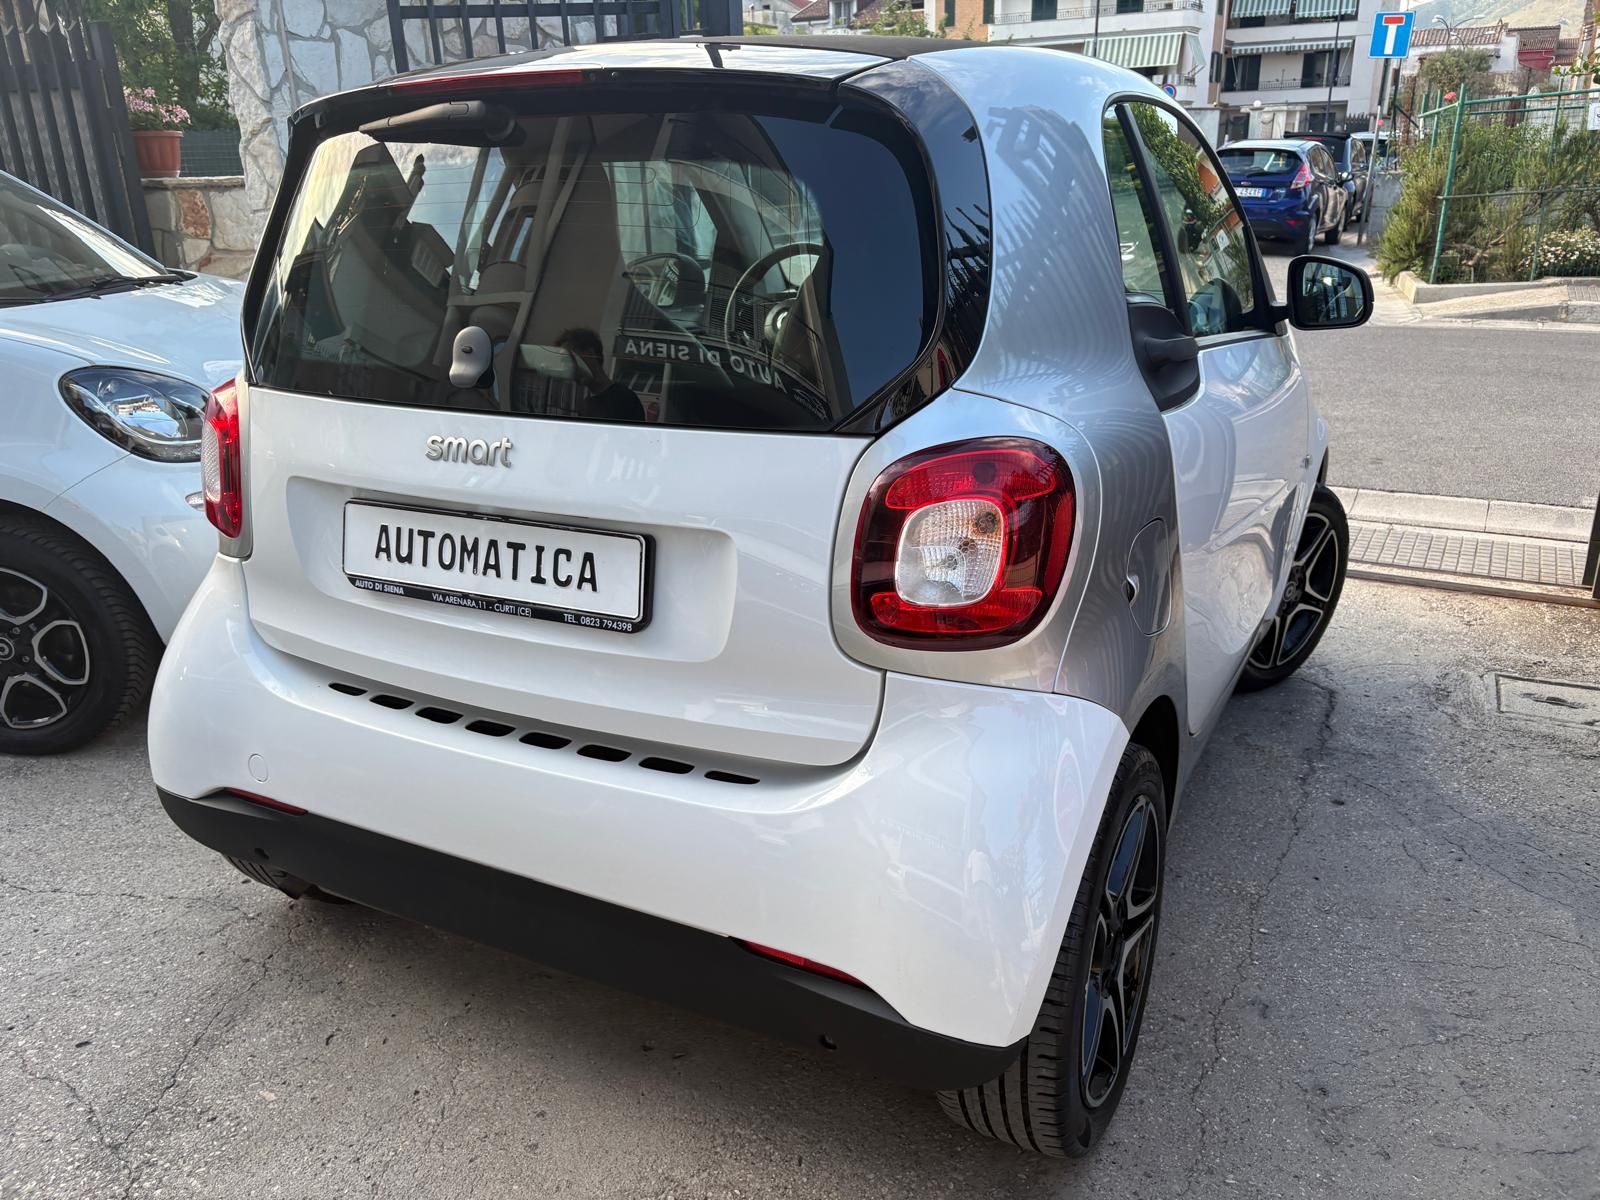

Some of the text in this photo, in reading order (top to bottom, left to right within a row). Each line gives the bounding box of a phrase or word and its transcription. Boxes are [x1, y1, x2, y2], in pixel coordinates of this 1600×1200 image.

[425, 434, 514, 468] smart
[374, 523, 599, 593] AUTOMATICA
[355, 579, 405, 595] AUTO DI SIENA
[432, 592, 444, 602] VIA
[494, 603, 516, 614] CURTI
[517, 606, 532, 618] (CE)
[563, 613, 633, 632] TEL. 0823 794398
